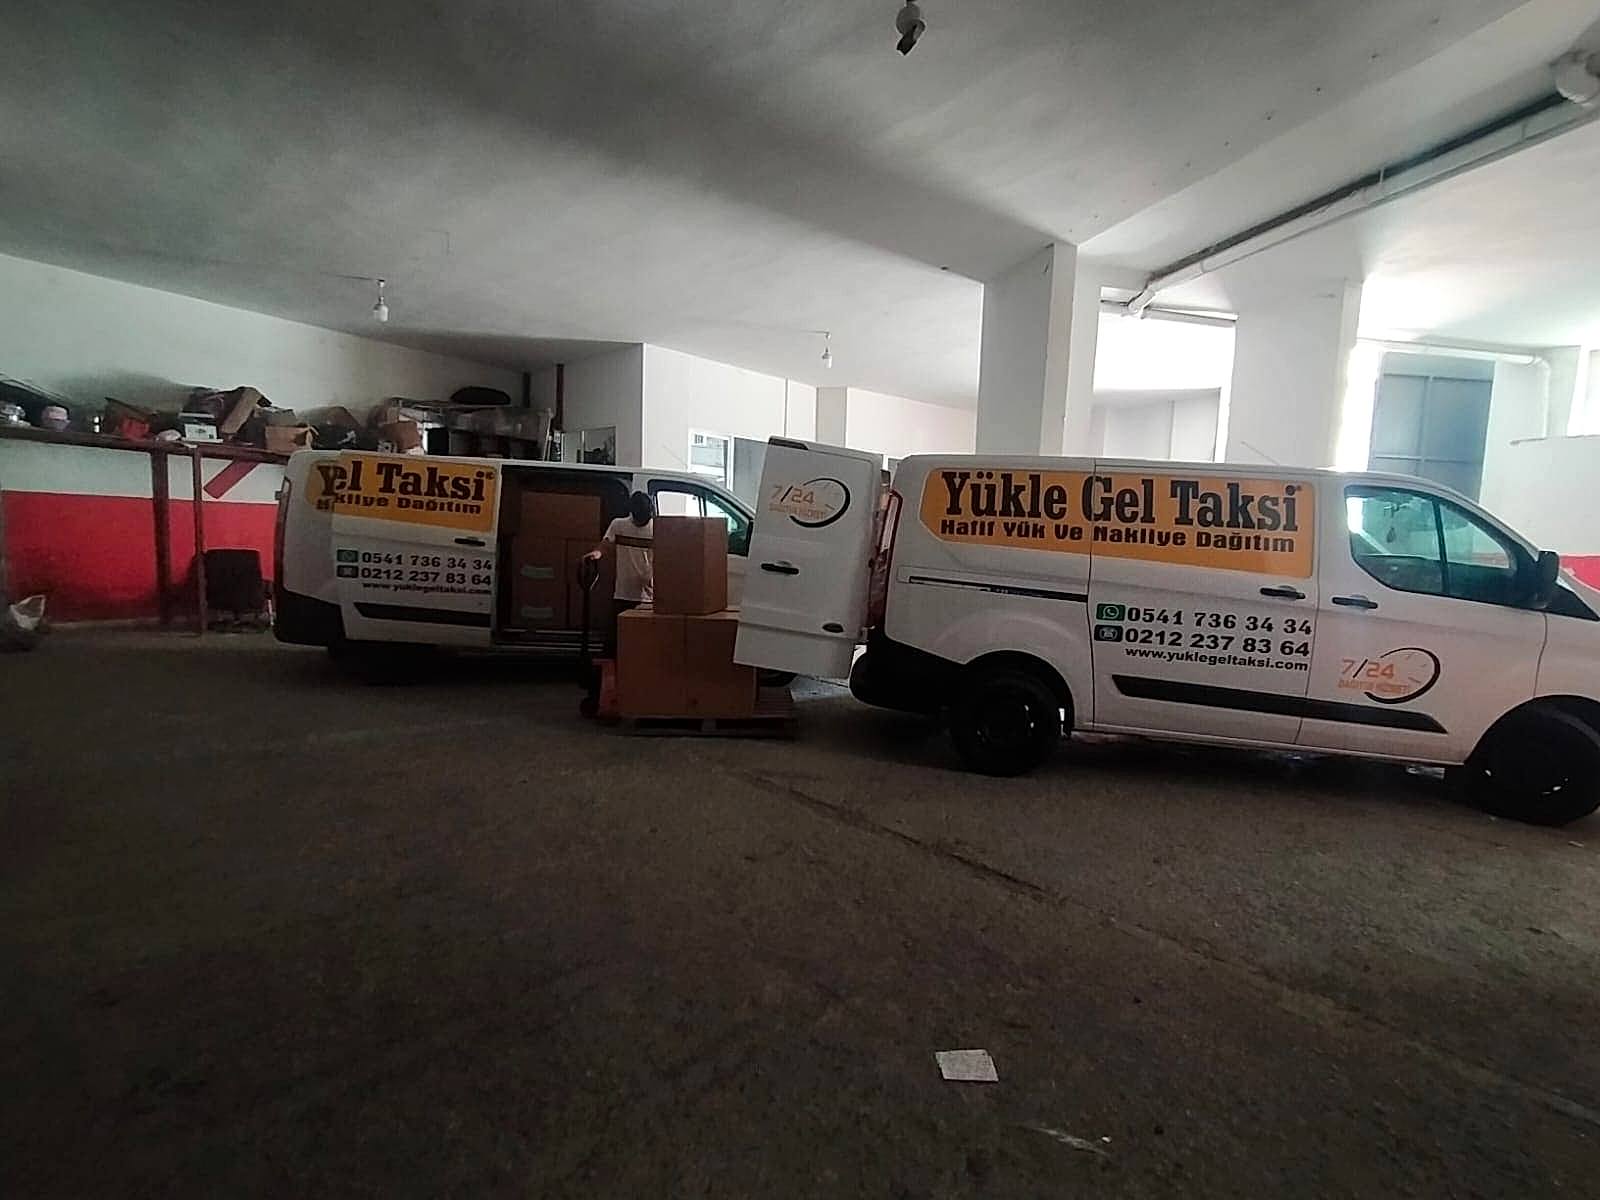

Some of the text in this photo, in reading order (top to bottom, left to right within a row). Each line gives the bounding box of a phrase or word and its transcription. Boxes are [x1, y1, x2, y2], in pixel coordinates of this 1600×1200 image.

[376, 462, 485, 502] Taksi
[772, 485, 815, 505] 7/24
[941, 470, 1299, 532] Yükle Gel Taksi
[940, 519, 996, 538] Hafif
[1002, 521, 1046, 539] Yük
[1092, 525, 1186, 546] Nakliye
[1196, 531, 1295, 552] Dağıtım
[361, 552, 492, 571] 0541 736 34 34
[360, 567, 492, 586] 0212 237 83 64
[1127, 607, 1312, 636] 0541 736 34 34
[1124, 628, 1311, 657] 0212 237 83 64
[1125, 646, 1309, 673] www.yuklegeltaksi.com
[1341, 657, 1395, 679] 7/24
